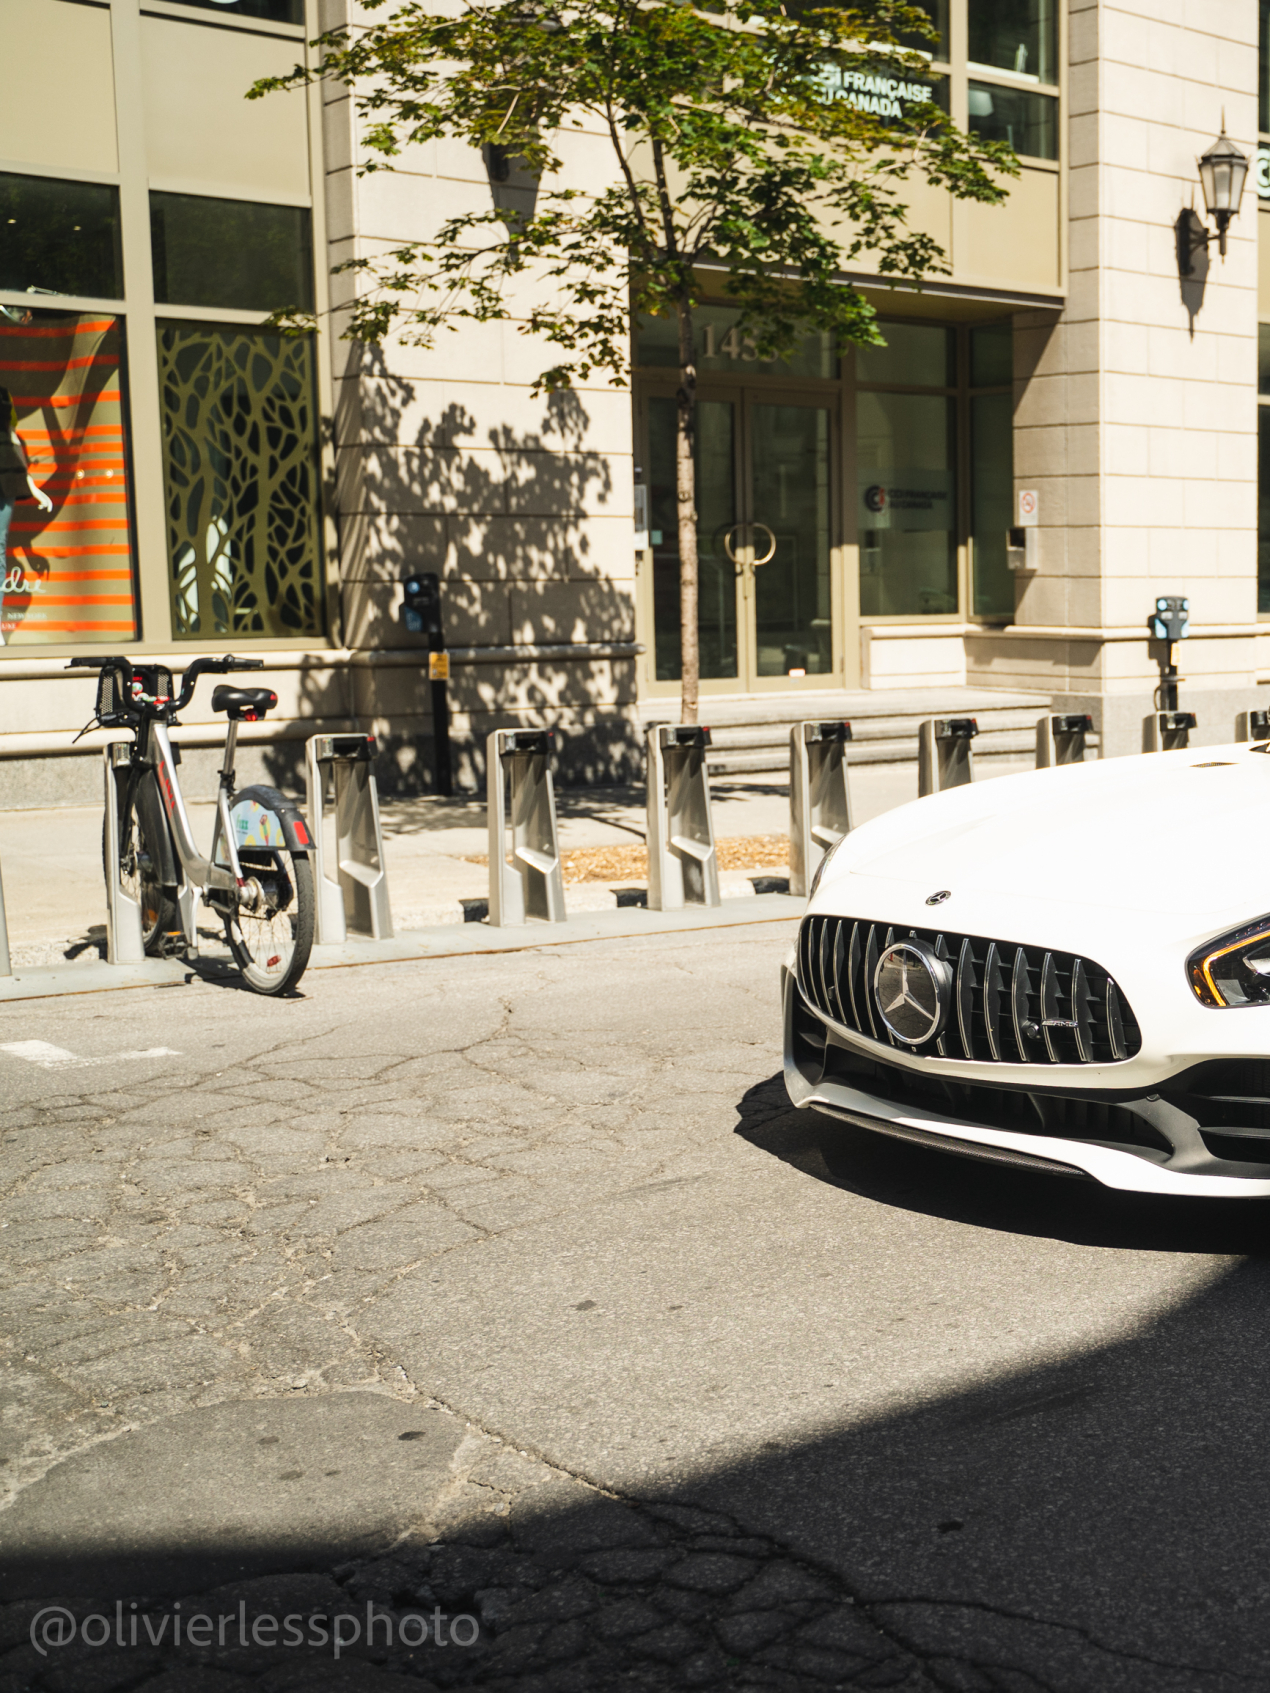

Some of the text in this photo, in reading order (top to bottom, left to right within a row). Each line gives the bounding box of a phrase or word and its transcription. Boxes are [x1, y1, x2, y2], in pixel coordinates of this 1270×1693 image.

[843, 71, 933, 103] FRANÇAISE
[836, 90, 903, 119] CANADA
[701, 322, 779, 363] 145
